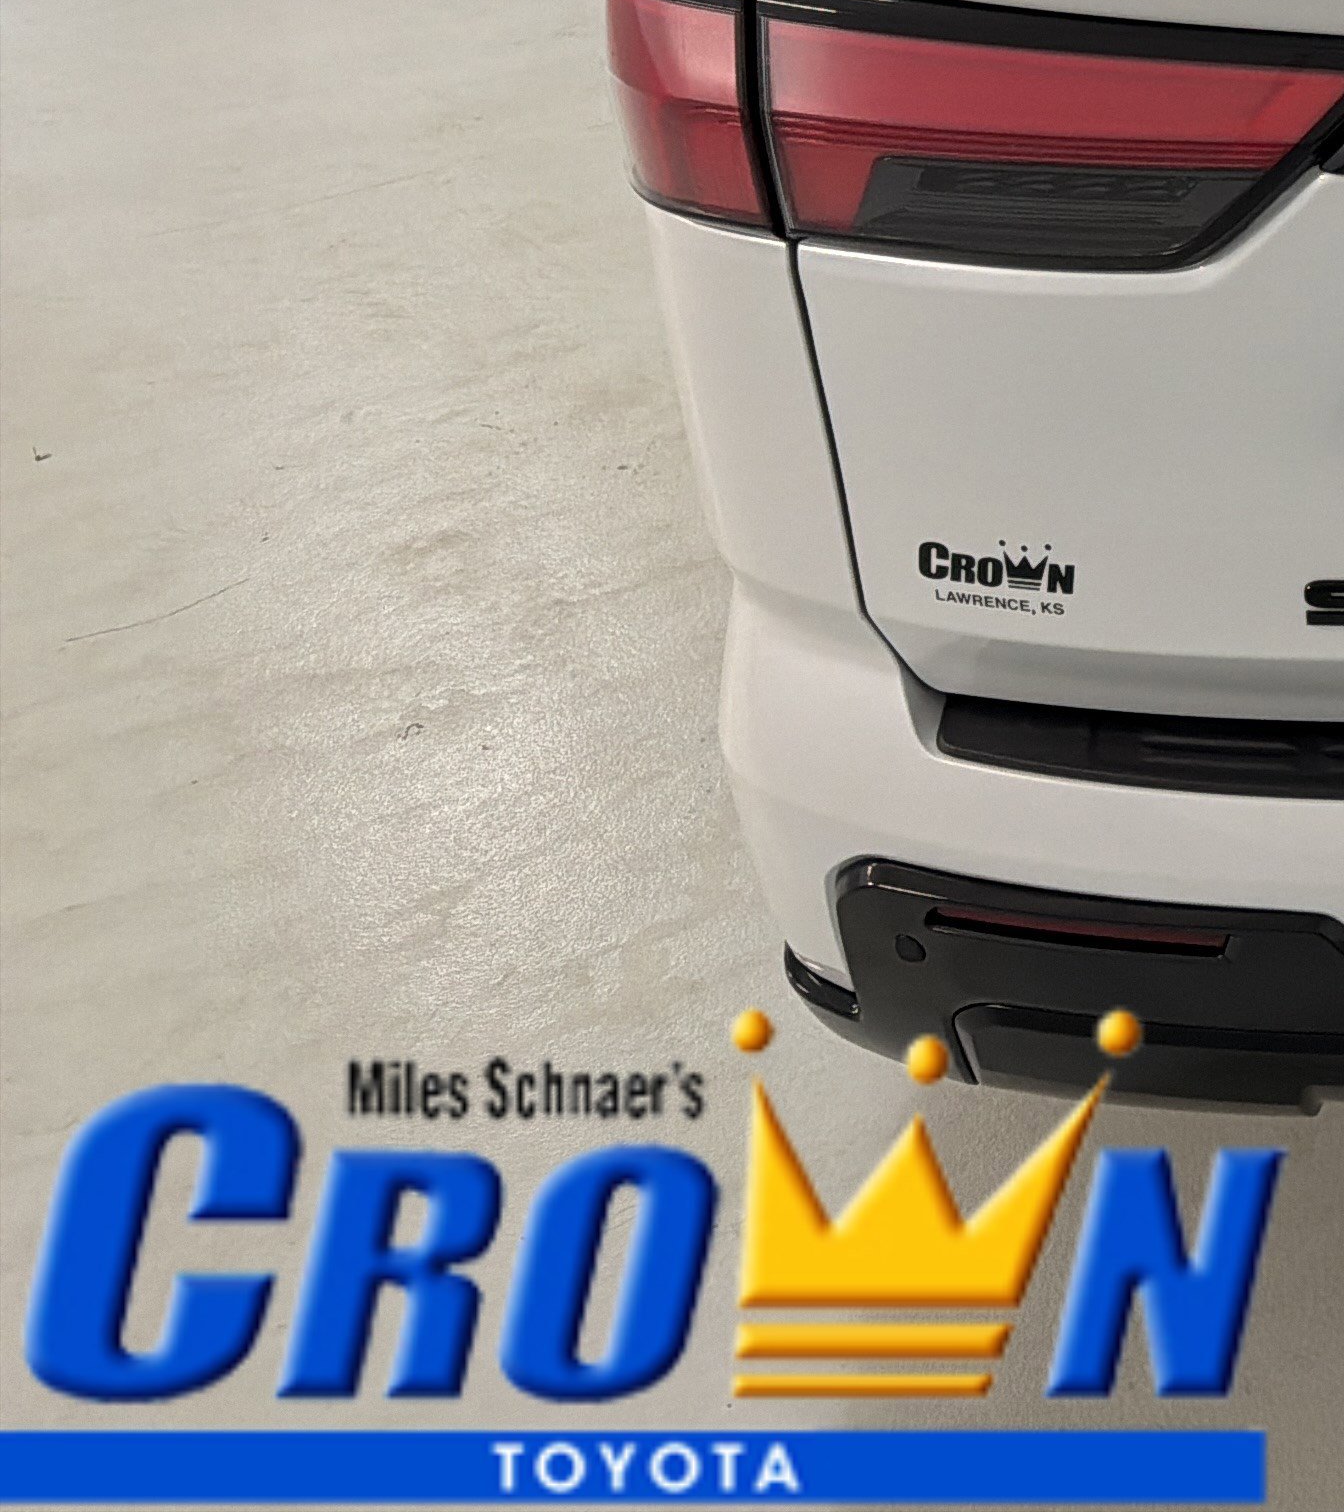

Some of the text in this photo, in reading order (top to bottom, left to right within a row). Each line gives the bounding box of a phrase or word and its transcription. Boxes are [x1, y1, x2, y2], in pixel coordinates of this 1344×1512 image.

[918, 539, 1076, 595] CROWN
[934, 588, 1065, 616] LAWRENCE, KS
